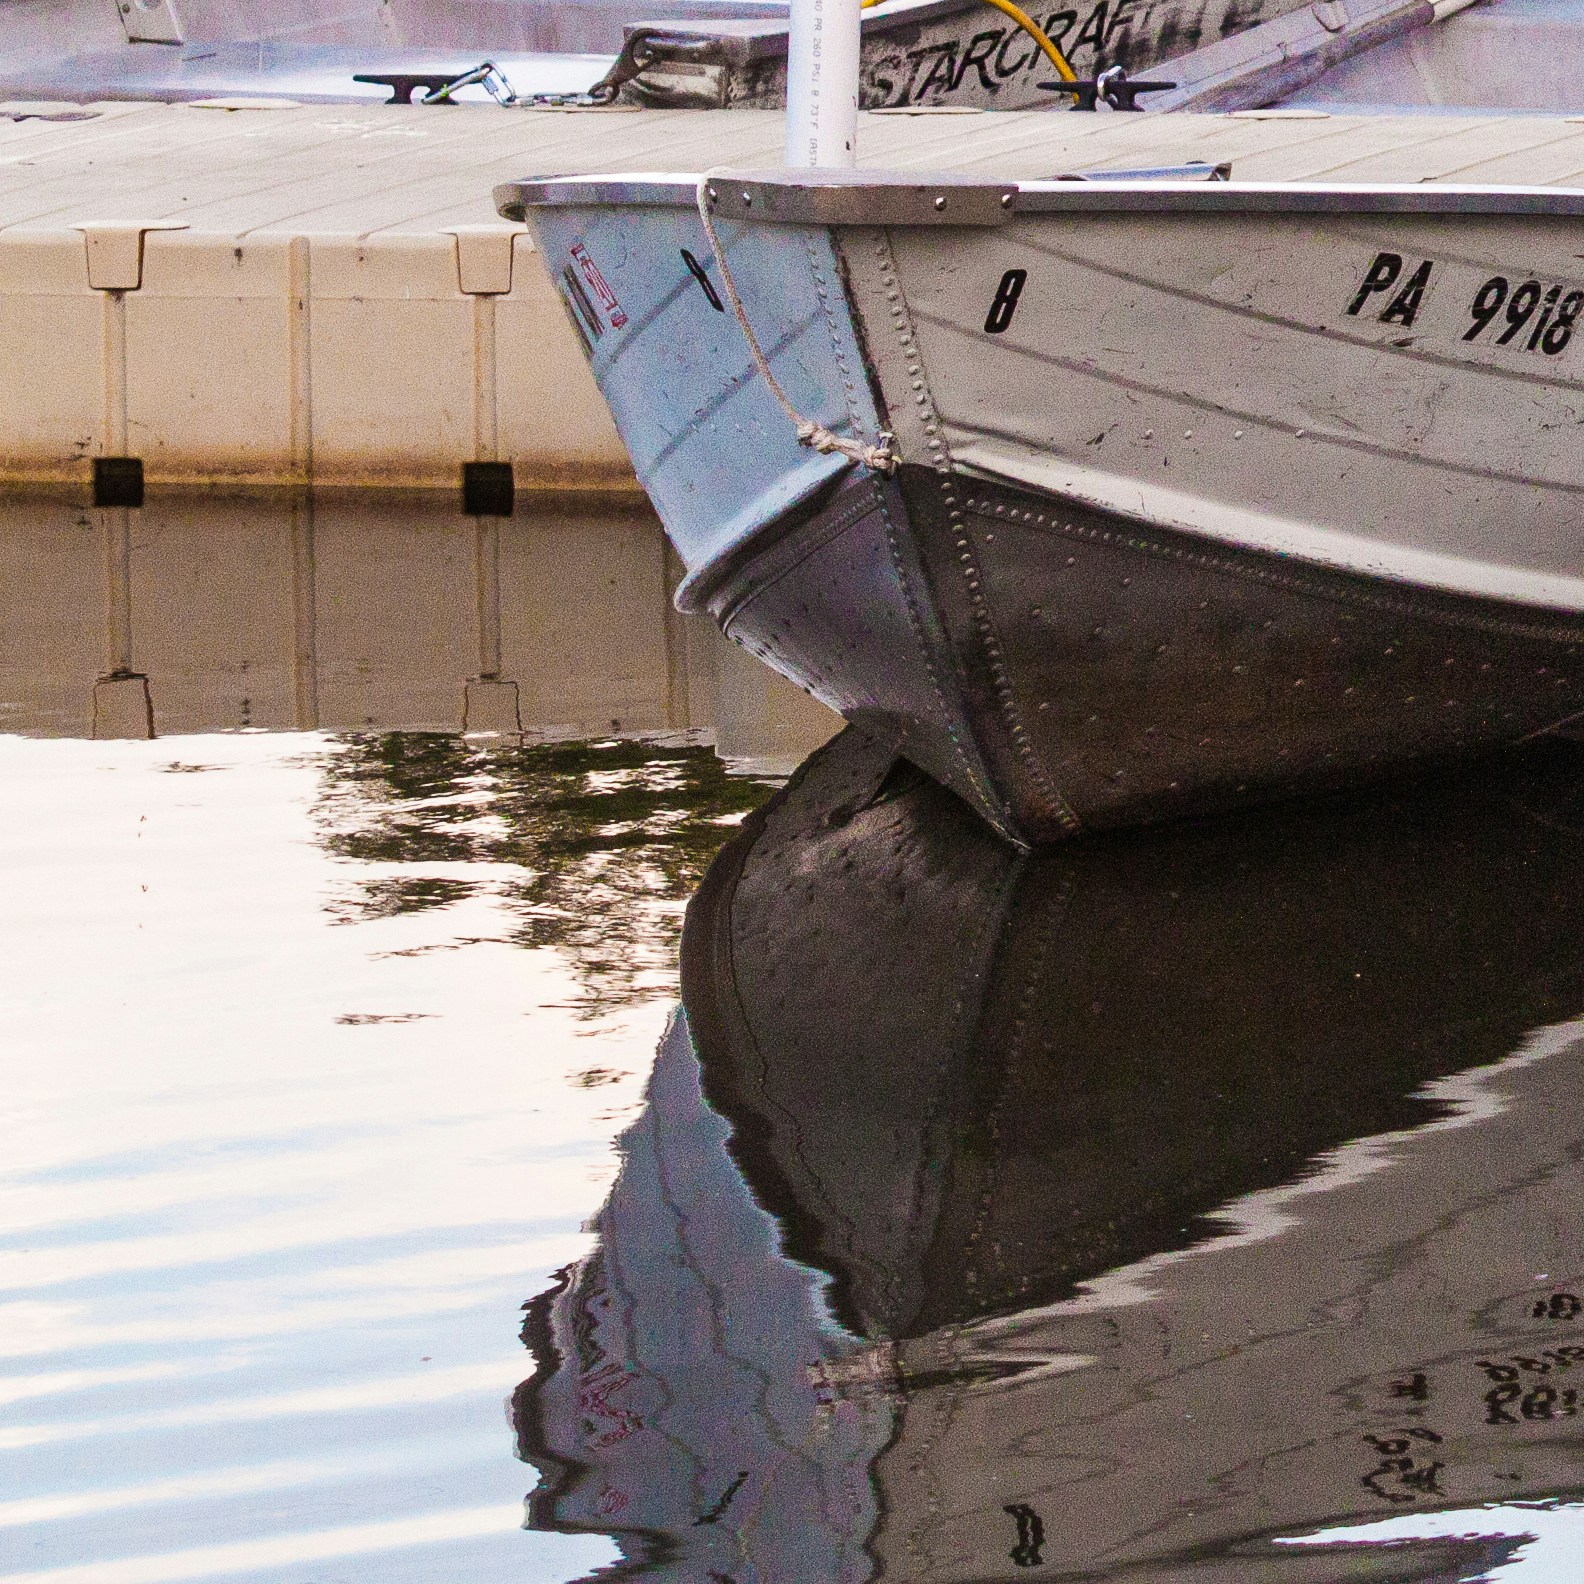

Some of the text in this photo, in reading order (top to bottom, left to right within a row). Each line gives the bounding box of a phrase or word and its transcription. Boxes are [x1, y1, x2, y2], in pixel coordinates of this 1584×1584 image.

[680, 248, 724, 312] 8
[983, 268, 1028, 333] 8
[1349, 253, 1434, 327] PA
